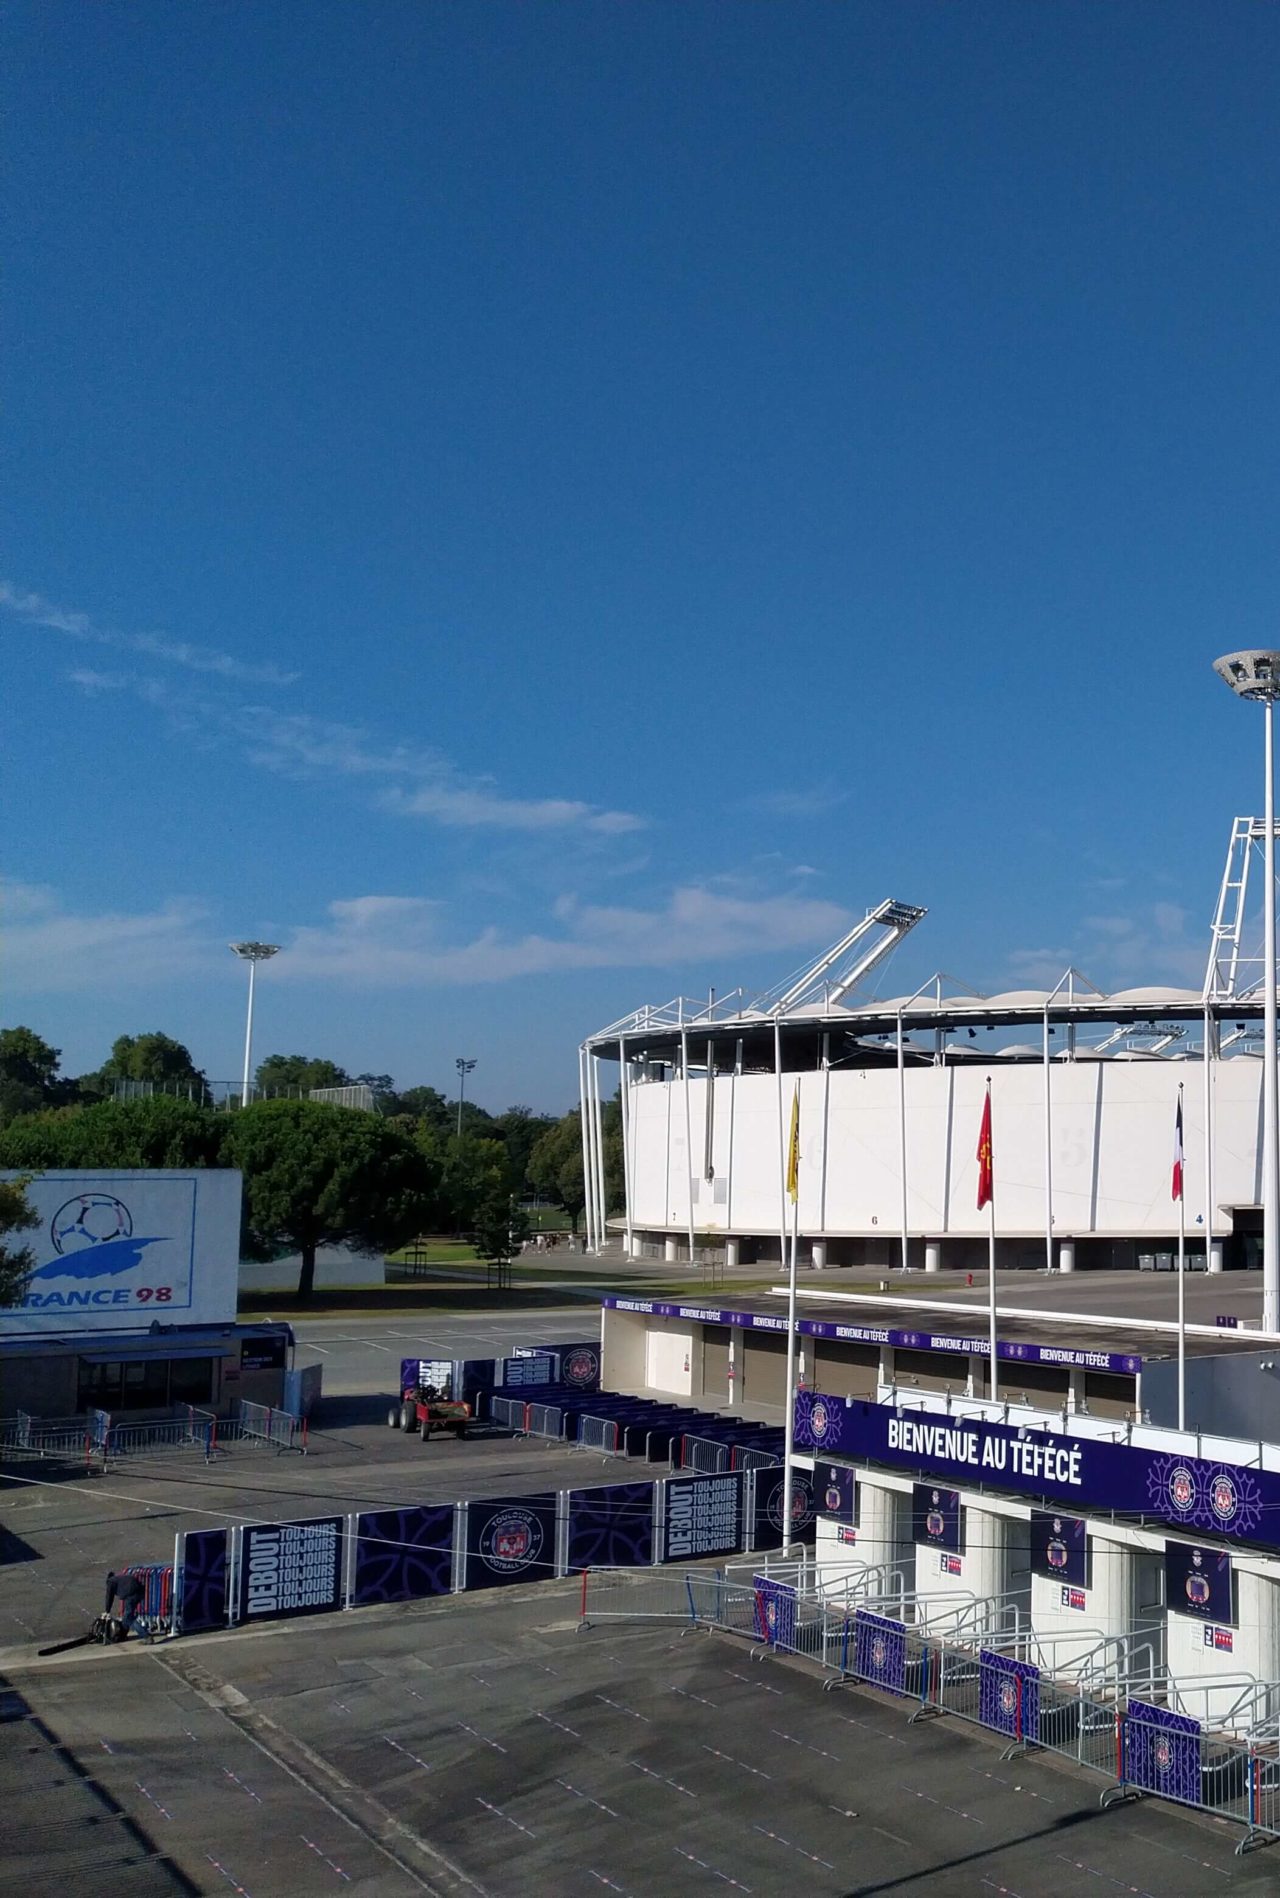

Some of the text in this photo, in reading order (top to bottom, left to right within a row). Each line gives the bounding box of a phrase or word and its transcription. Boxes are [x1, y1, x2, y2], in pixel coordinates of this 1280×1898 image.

[22, 1287, 172, 1308] RANCE 98
[753, 1316, 776, 1328] BIENVENUE
[776, 1320, 783, 1329] AU
[836, 1326, 862, 1339] BIENVENUE
[863, 1329, 870, 1340] AU
[931, 1337, 961, 1350] BIENVENUE
[962, 1341, 970, 1351] AU
[1040, 1348, 1110, 1367] BIENVENUE AU TÉFÉCÉ
[888, 1418, 1083, 1485] BIENVENUE AU TÉFÉCÉ
[692, 1478, 737, 1493] TOUJOURS
[692, 1490, 737, 1505] TOUJOURS
[692, 1501, 737, 1516] TOUJOURS
[491, 1511, 534, 1527] TOULOUSE
[668, 1484, 693, 1557] DEBOUT
[692, 1513, 737, 1529] TOUJOURS
[280, 1523, 336, 1541] TOUJOURS
[279, 1537, 336, 1555] TOUJOURS
[692, 1536, 737, 1553] TOUJOURS
[279, 1550, 335, 1568] TOUJOURS
[247, 1531, 280, 1614] DEBOUT
[278, 1563, 335, 1582] TOUJOURS
[277, 1577, 334, 1596] TOUJOURS
[276, 1590, 334, 1610] TOUJOURS
